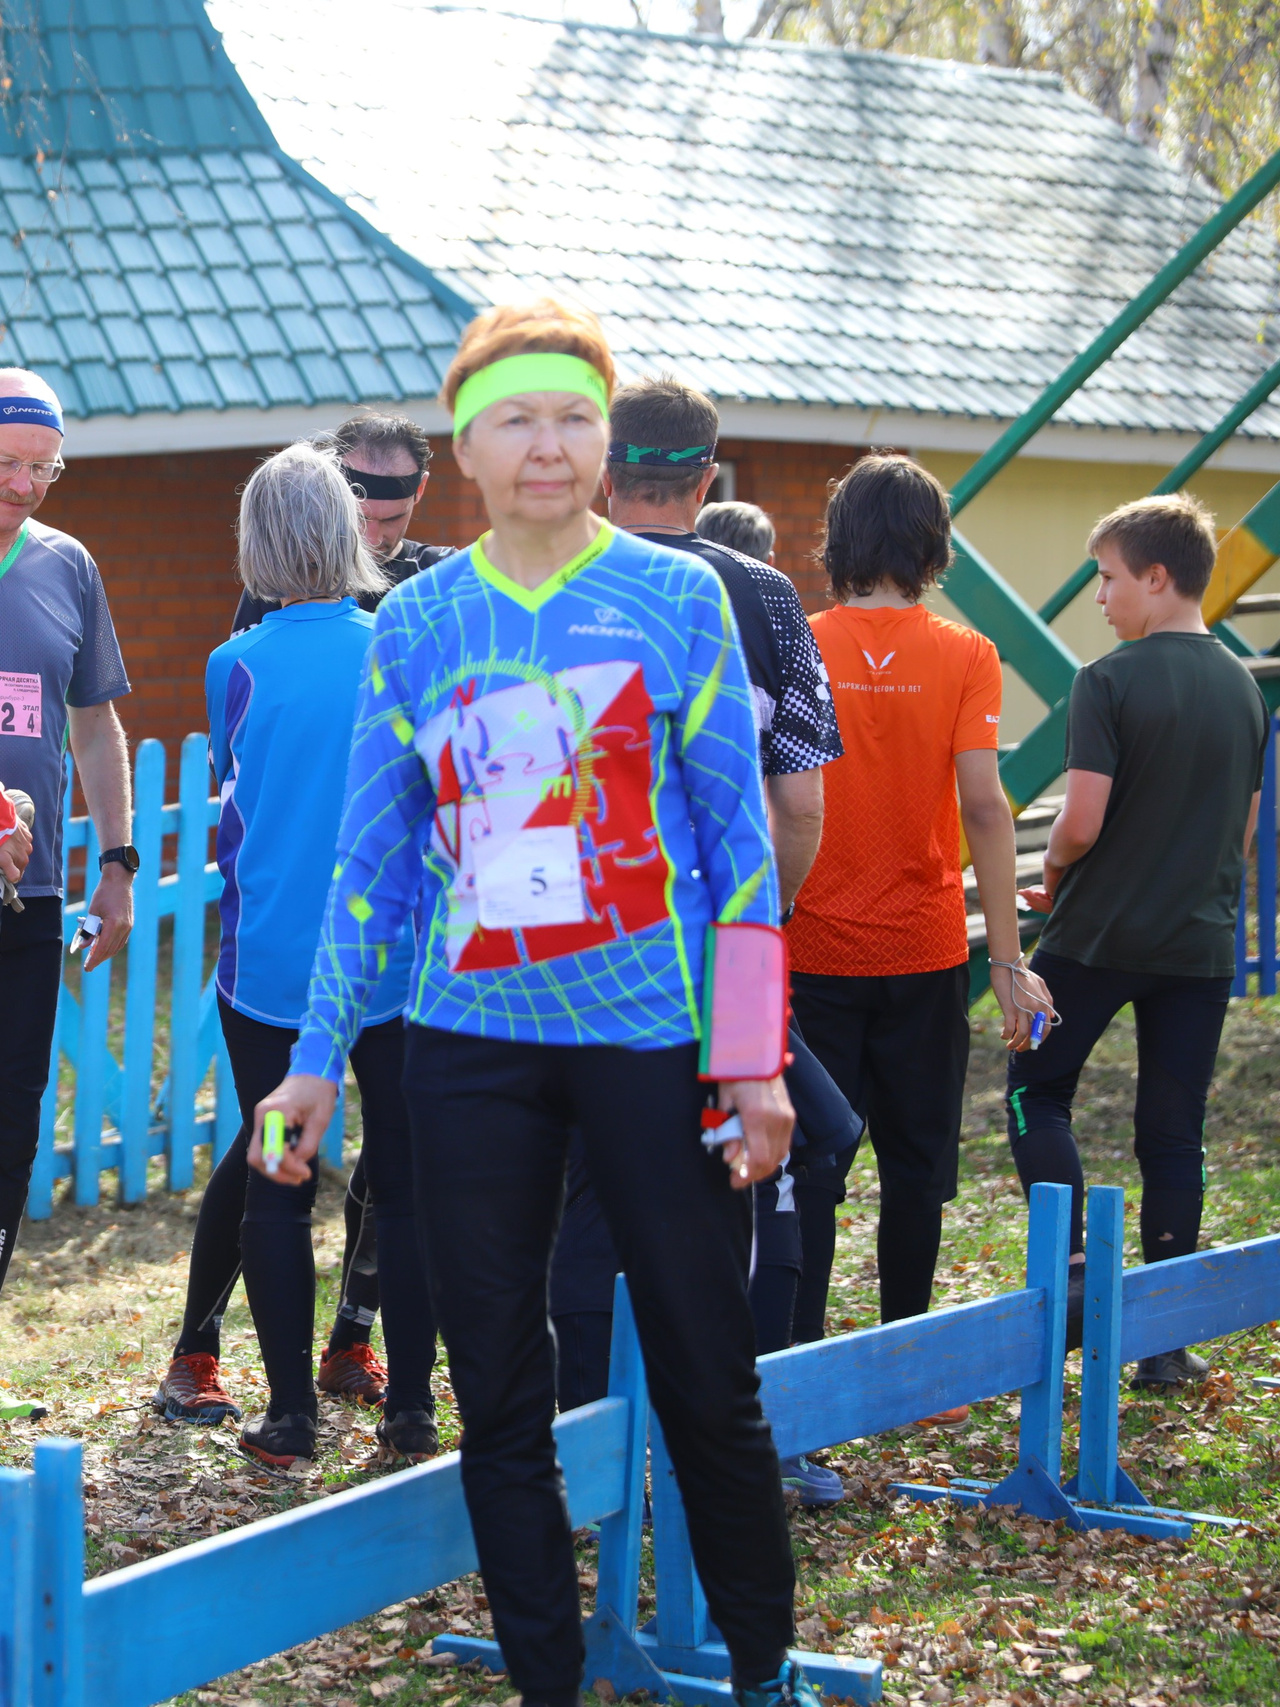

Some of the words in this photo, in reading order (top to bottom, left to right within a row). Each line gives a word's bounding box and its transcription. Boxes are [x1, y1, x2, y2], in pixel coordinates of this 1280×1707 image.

[18, 407, 53, 416] NORD
[567, 624, 642, 641] NORD
[874, 684, 895, 693] БЕГОМ
[897, 685, 906, 693] 10
[907, 685, 922, 693] ЛЕТ
[27, 713, 35, 733] 4
[530, 866, 547, 896] 5
